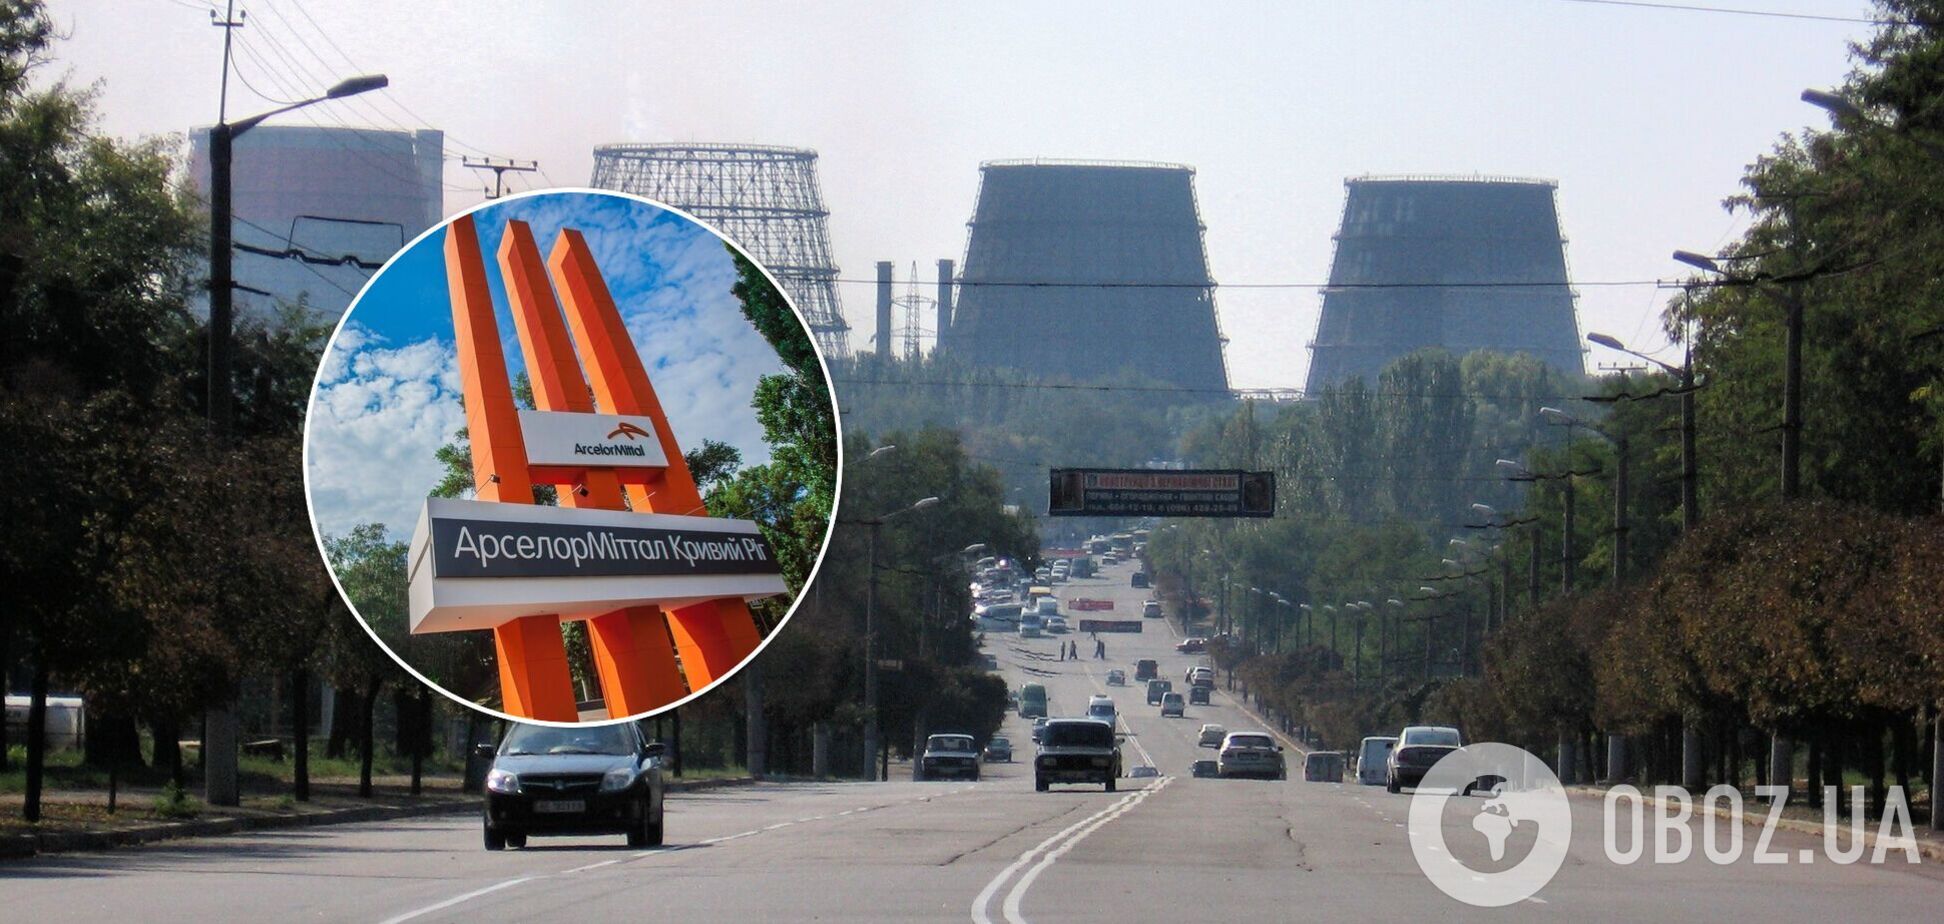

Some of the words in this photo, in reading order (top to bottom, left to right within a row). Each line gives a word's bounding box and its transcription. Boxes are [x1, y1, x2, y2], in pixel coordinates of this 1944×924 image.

[574, 442, 646, 457] ArcelorMittal
[454, 526, 669, 567] АрселорМіттал
[668, 535, 745, 567] Кривий
[742, 538, 766, 561] Ріг
